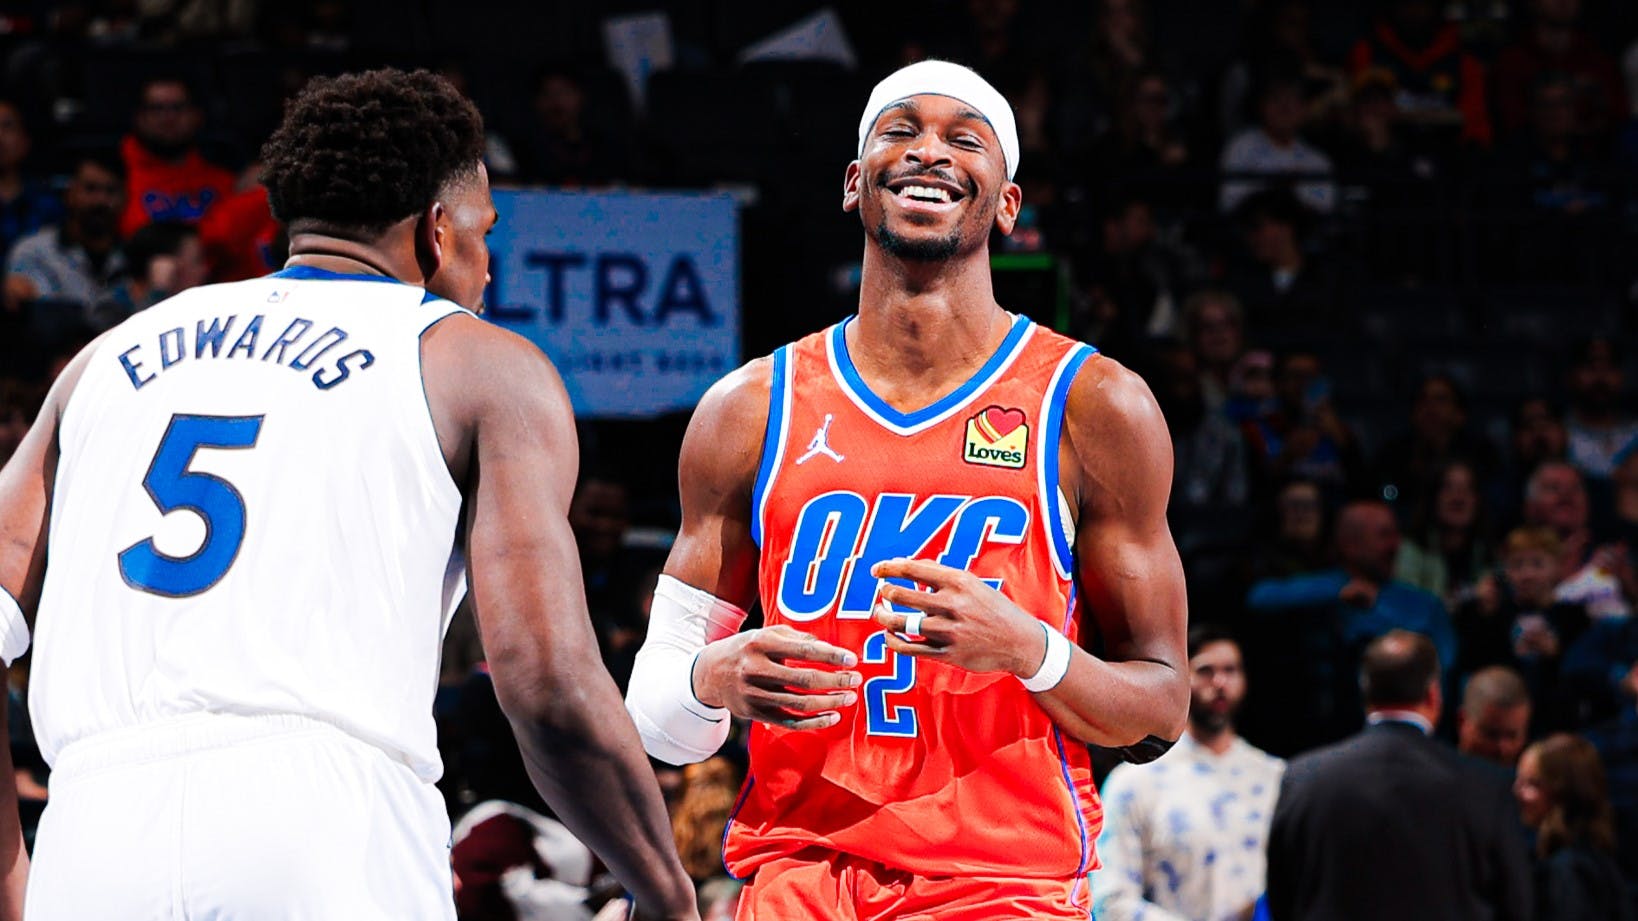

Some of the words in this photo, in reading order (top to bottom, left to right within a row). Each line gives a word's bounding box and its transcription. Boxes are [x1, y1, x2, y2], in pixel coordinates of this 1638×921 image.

[487, 251, 719, 327] LTRA
[117, 314, 376, 391] EDWARDS
[117, 412, 266, 598] 5
[776, 490, 1030, 622] OKC
[862, 631, 918, 738] 2
